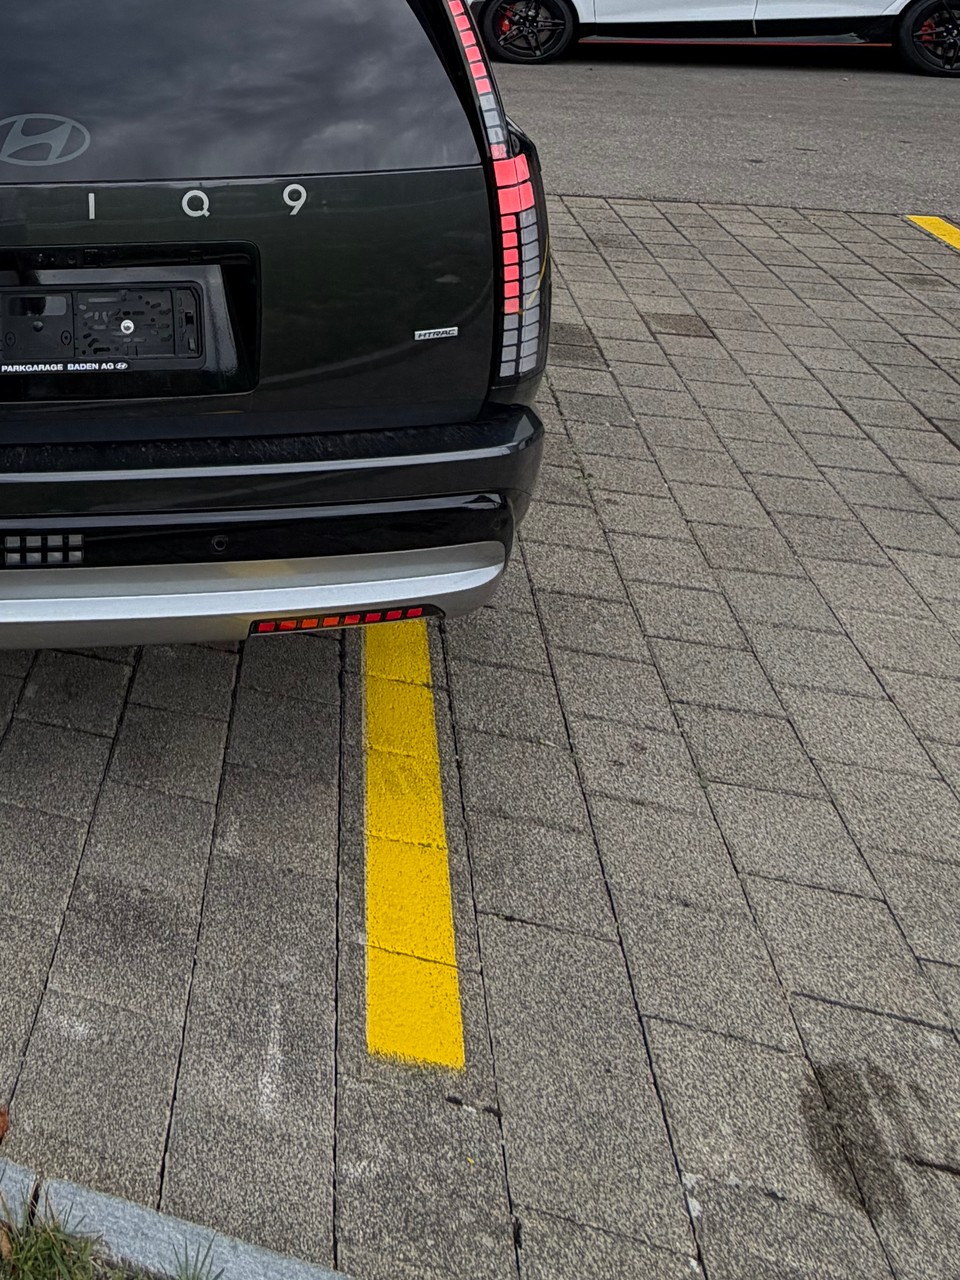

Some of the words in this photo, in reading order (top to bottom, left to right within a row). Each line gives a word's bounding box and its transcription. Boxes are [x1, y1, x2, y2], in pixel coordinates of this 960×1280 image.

[417, 328, 457, 339] HTRAC
[1, 363, 63, 372] PARKGARAGE
[101, 362, 114, 370] AG
